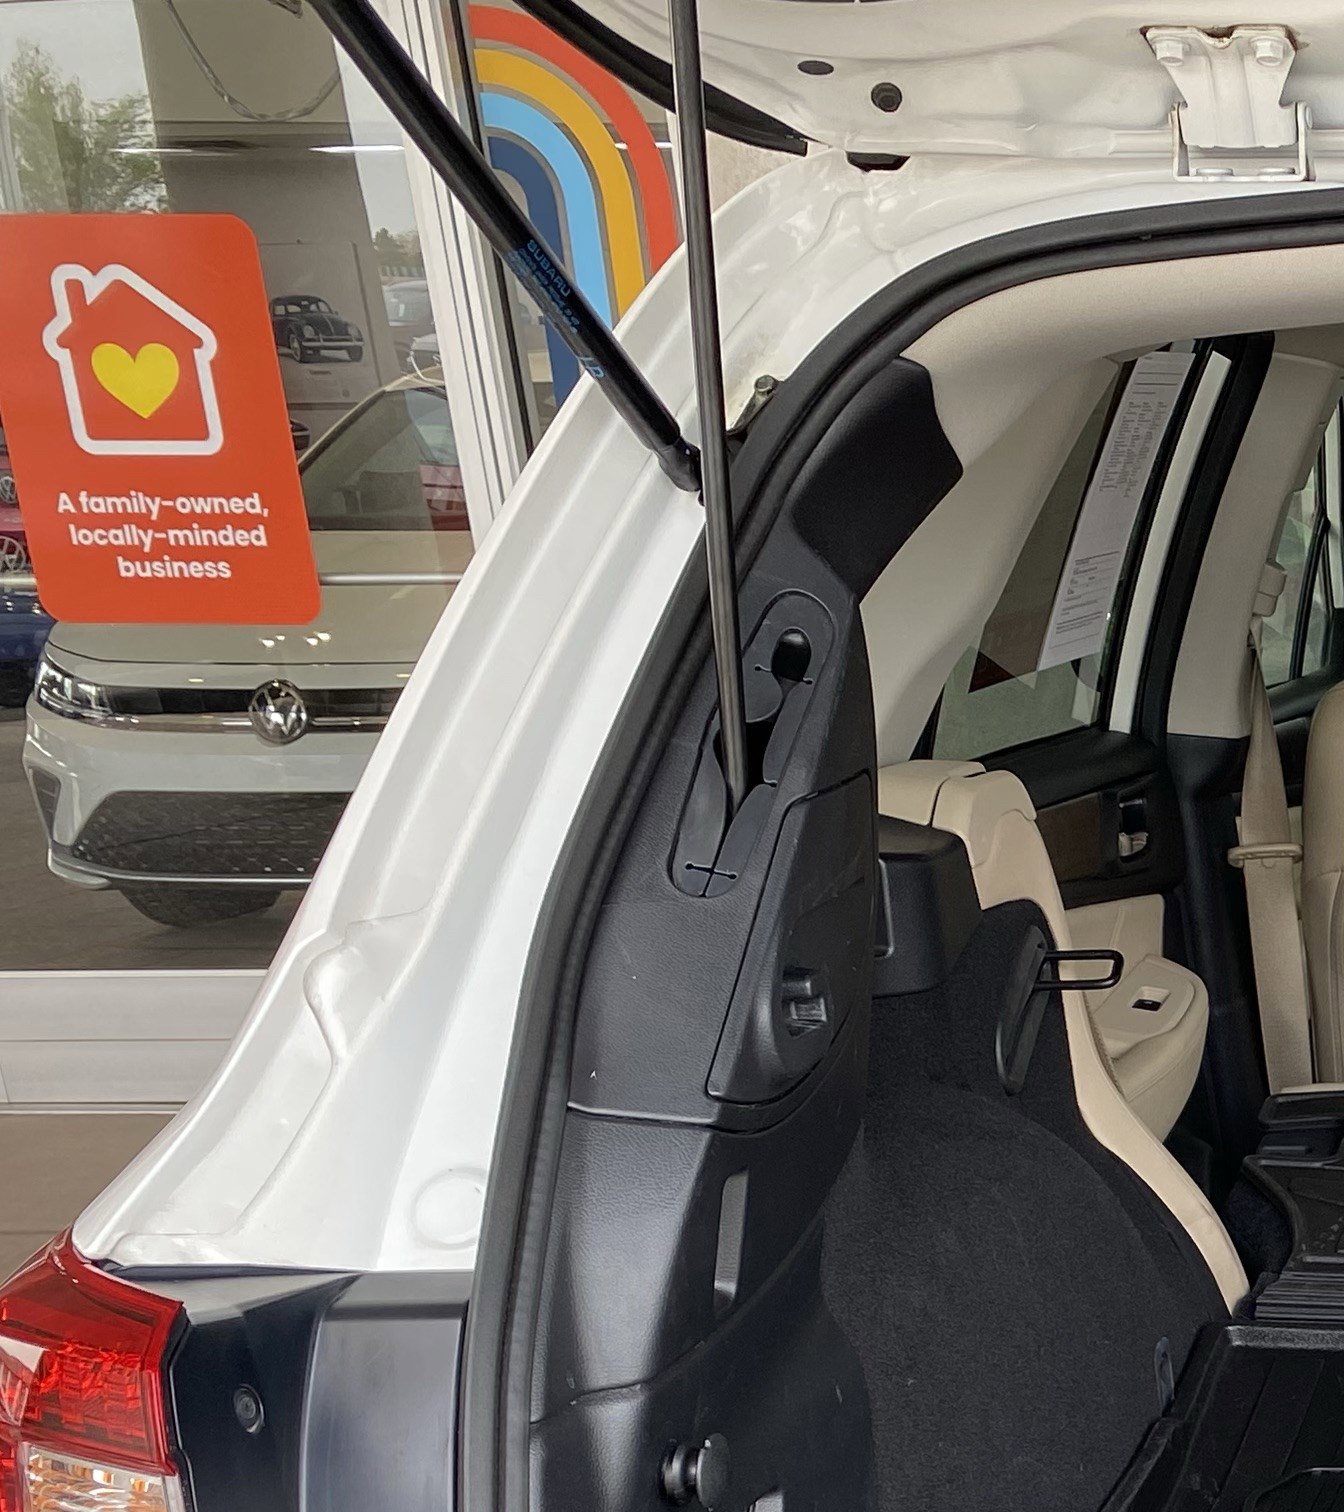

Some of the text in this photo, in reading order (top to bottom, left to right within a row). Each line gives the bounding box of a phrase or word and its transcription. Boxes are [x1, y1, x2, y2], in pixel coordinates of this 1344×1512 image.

[527, 239, 571, 298] SUBARU
[57, 490, 269, 520] A family-owned,
[68, 523, 268, 553] locally-minded
[117, 555, 232, 578] business
